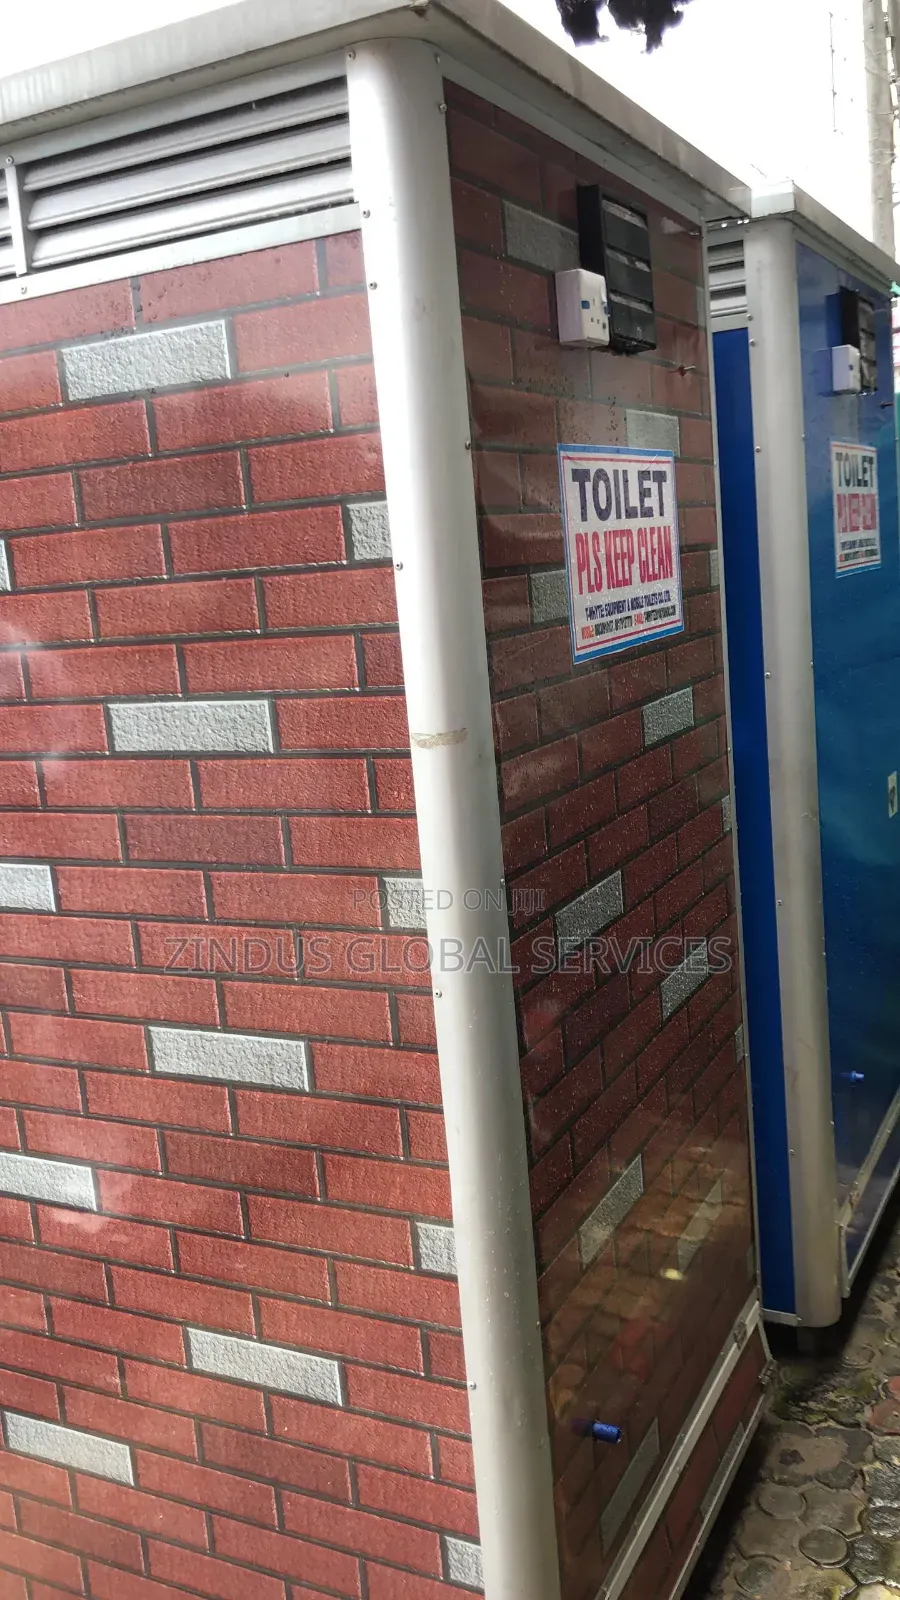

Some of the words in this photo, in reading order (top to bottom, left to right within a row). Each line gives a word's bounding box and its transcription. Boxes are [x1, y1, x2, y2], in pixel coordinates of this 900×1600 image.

[571, 468, 667, 522] TOILET
[836, 452, 874, 487] TOILET
[575, 531, 603, 595] PLS
[604, 528, 635, 590] KEEP
[637, 525, 674, 584] CLEAN
